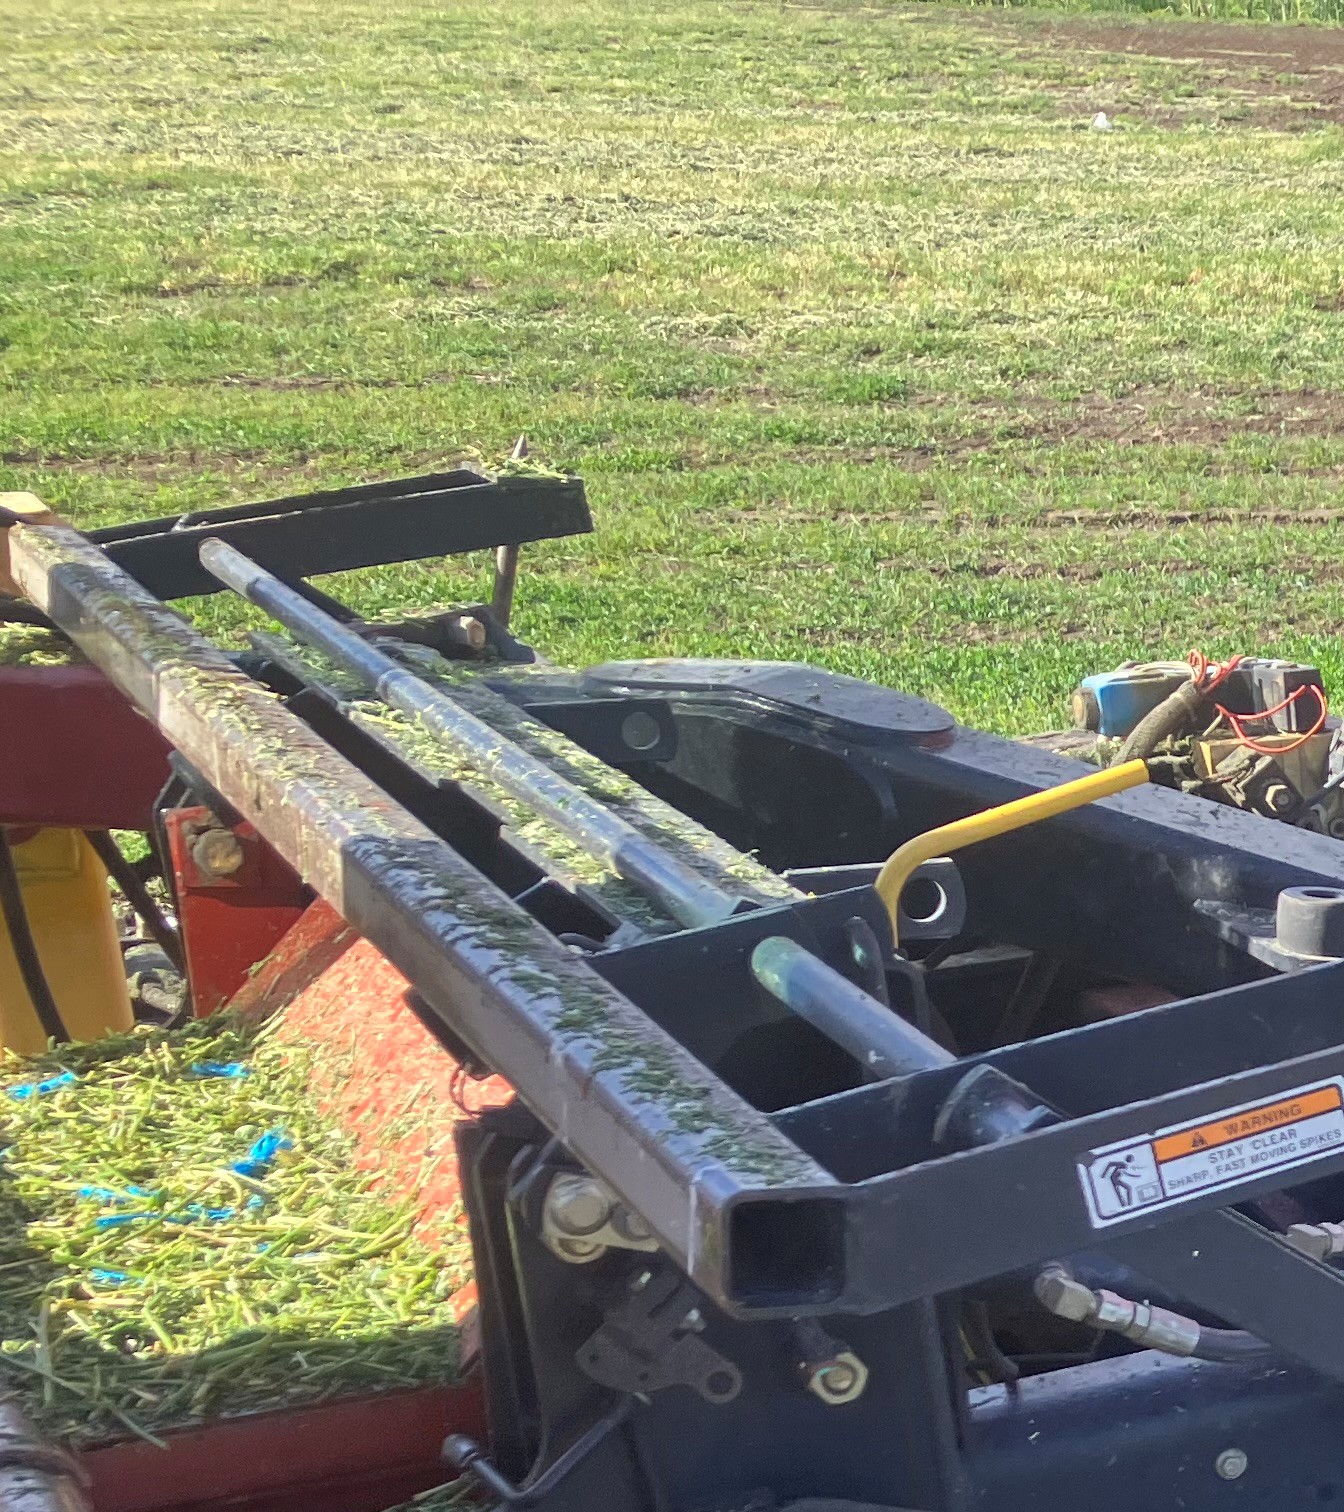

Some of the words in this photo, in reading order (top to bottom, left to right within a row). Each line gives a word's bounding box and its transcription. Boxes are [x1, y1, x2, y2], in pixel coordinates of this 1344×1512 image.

[1224, 1104, 1301, 1136] WARNING
[1208, 1144, 1244, 1164] STAY
[1251, 1128, 1298, 1151] CLEAR
[1216, 1158, 1246, 1175] FAST
[1251, 1143, 1297, 1165] MOVING
[1300, 1128, 1342, 1150] SPIKES
